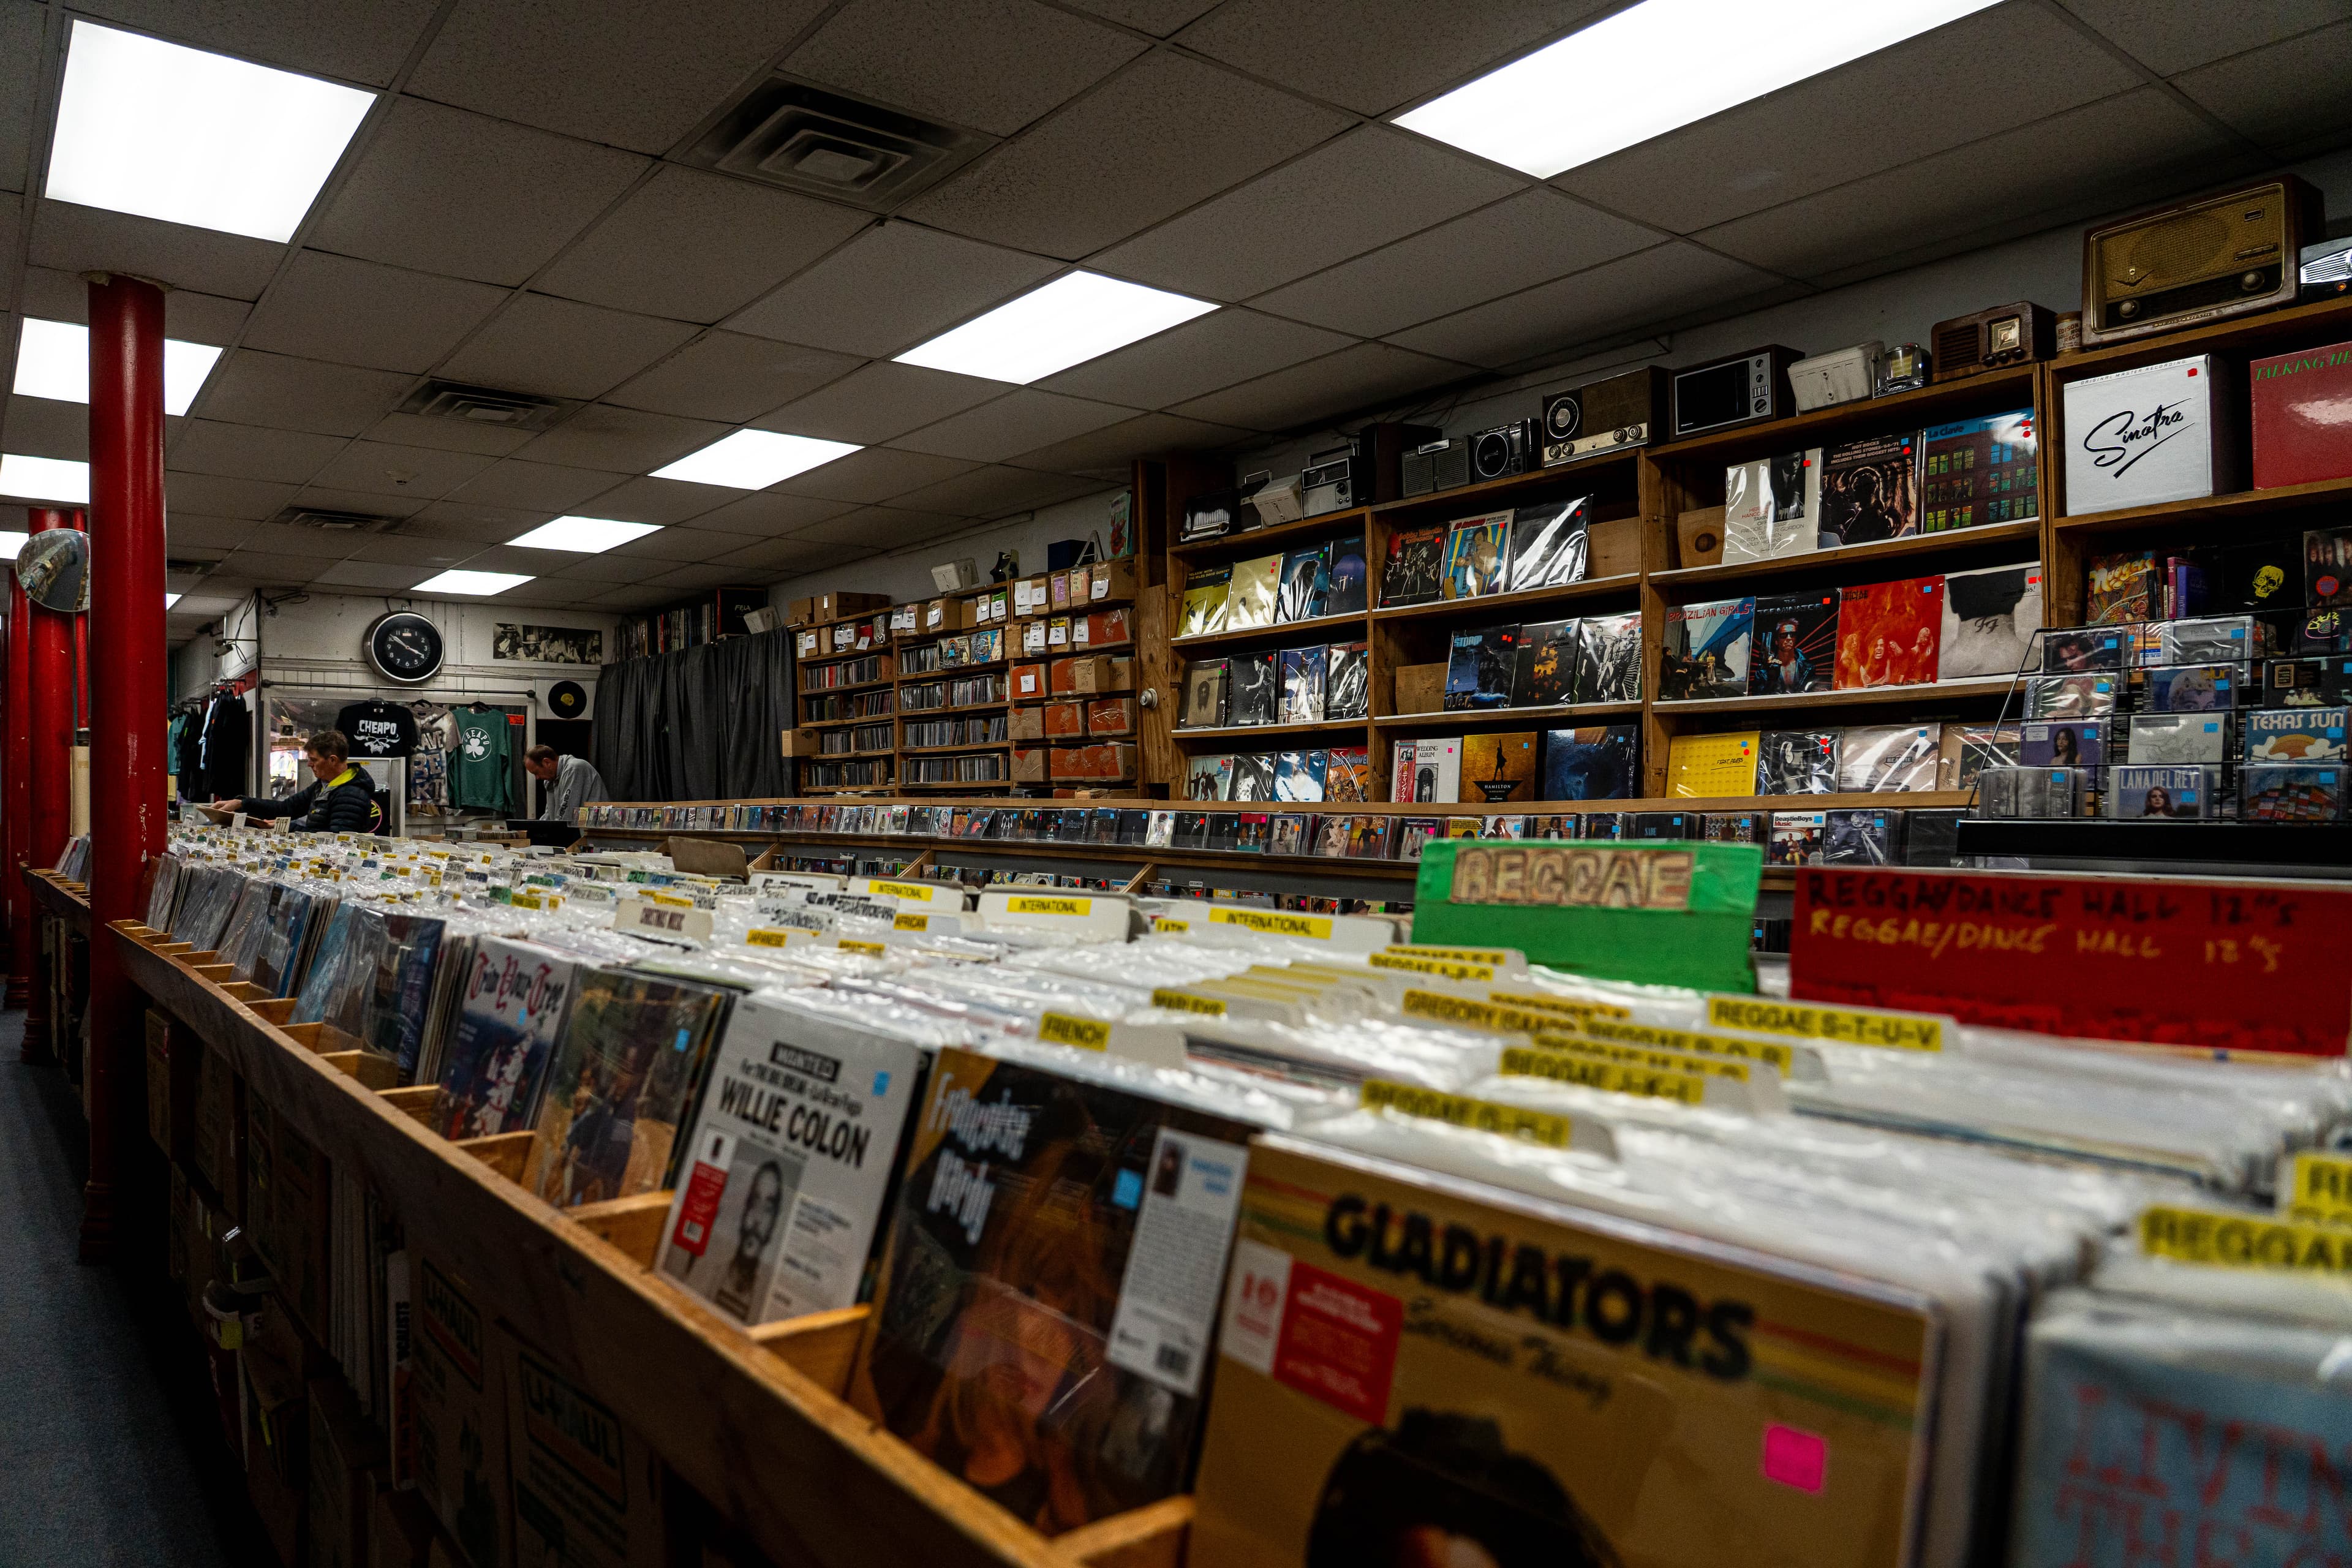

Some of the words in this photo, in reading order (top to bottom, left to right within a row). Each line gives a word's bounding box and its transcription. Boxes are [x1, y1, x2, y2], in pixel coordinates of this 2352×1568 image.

[2058, 323, 2079, 334] EDISON
[2081, 375, 2112, 385] ORIGINAL
[2116, 368, 2143, 377] MASTER
[2146, 360, 2187, 371] RECORDING
[2255, 356, 2324, 381] TALKING
[2084, 398, 2192, 467] Sinatra
[358, 720, 398, 734] CHEAPO
[2250, 714, 2304, 731] TEXAS
[2309, 712, 2345, 729] SUN
[464, 728, 491, 746] CHEAPO
[2120, 770, 2152, 790] LANA
[2153, 770, 2172, 789] DEL
[2174, 769, 2197, 789] REY
[1644, 827, 1657, 837] SADE
[1453, 849, 1692, 909] REGGAE
[1018, 899, 1077, 914] INTERNATIONAL
[1226, 911, 1313, 935] INTERNATIONAL
[1043, 1014, 1106, 1046] FRENCH
[1716, 1001, 1814, 1036] REGGAE
[1819, 1011, 1940, 1049] S-T-U-V
[718, 1075, 789, 1137] WILLIE
[788, 1104, 872, 1172] COLON
[1325, 1194, 1757, 1382] GLADIATORS
